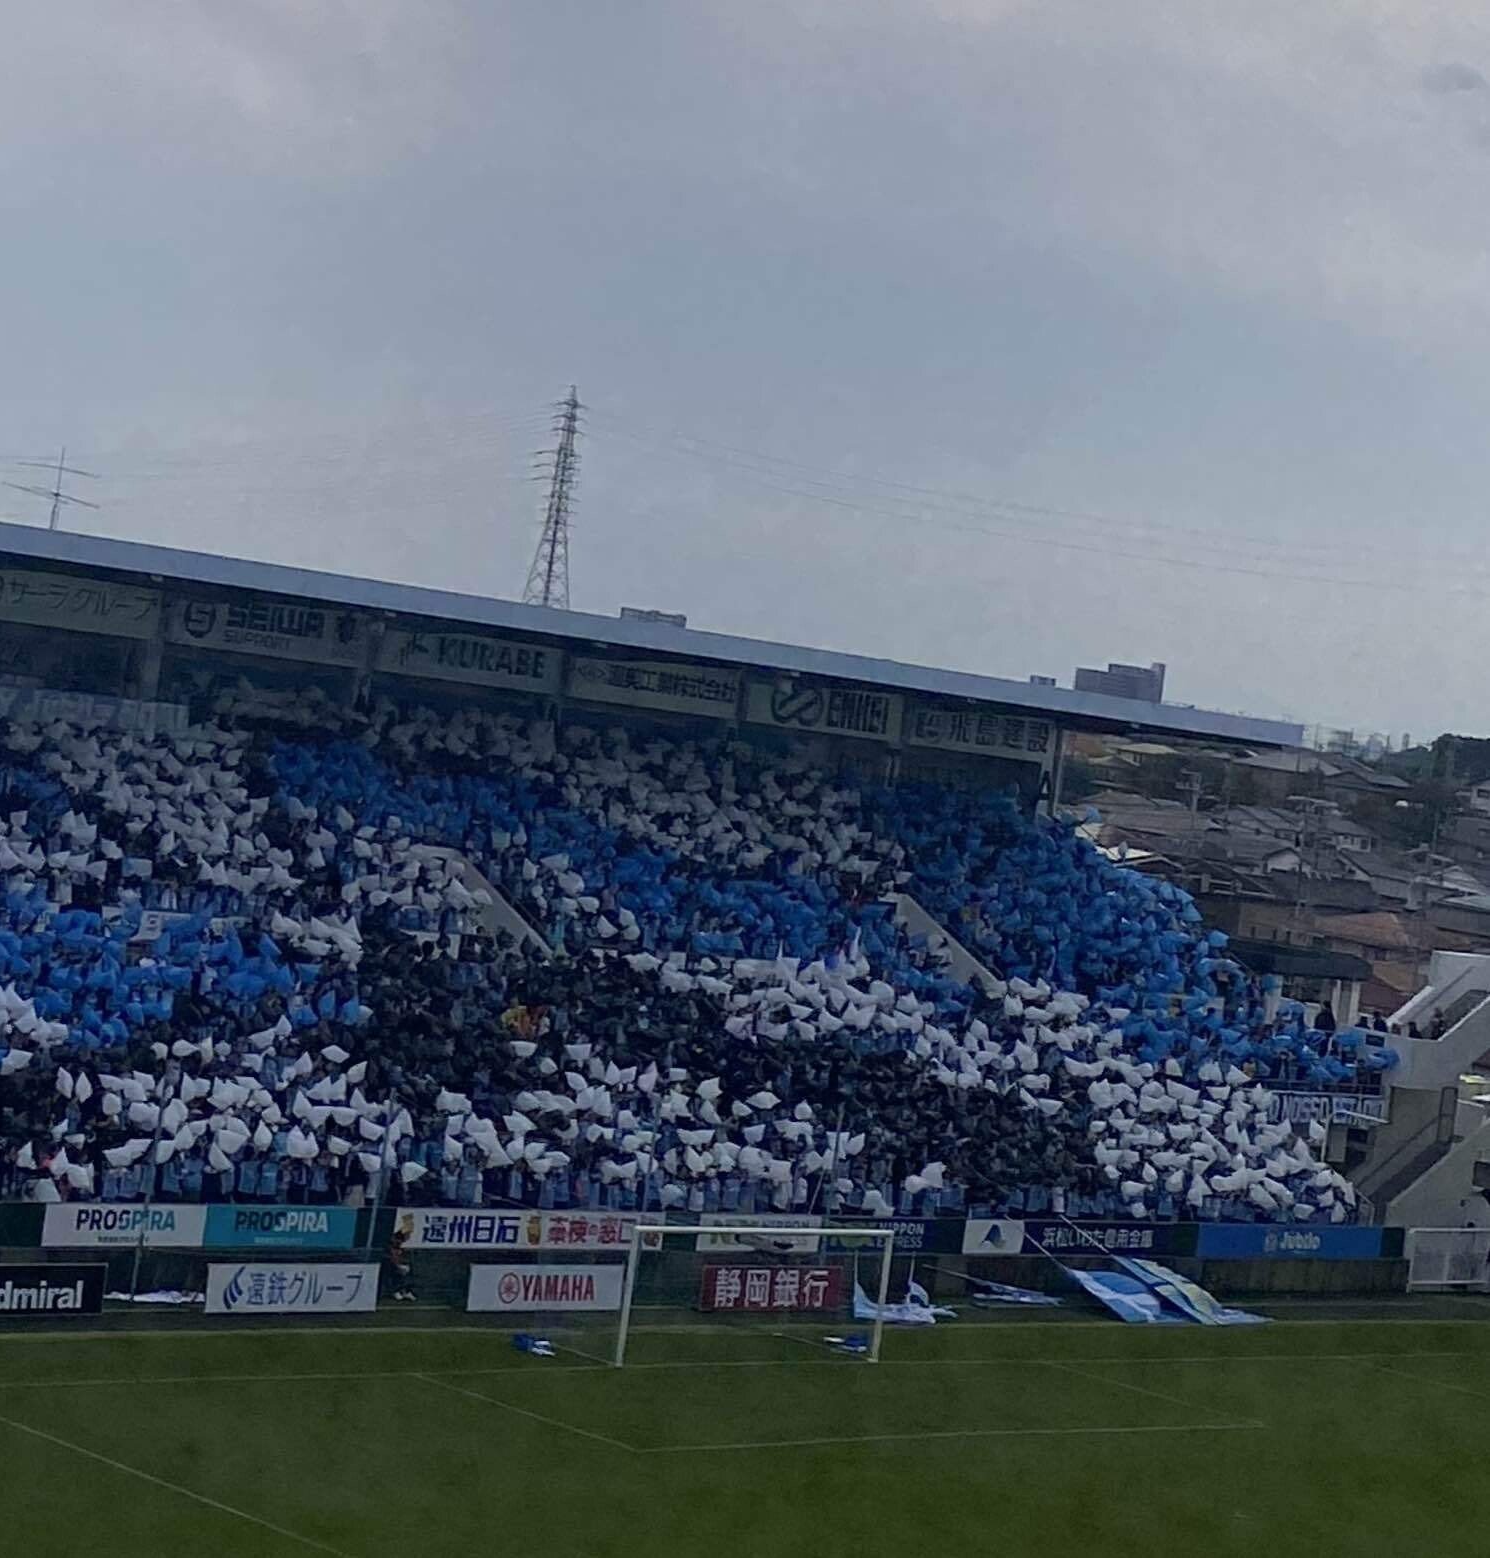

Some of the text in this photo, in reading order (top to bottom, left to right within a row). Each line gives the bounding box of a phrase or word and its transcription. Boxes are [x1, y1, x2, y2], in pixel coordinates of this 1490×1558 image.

[438, 636, 546, 679] KURABE
[950, 713, 1050, 753] 飛島建設
[75, 1209, 175, 1231] PROSPIRA
[234, 1211, 328, 1232] PROSPIRA
[421, 1214, 521, 1244] 遠州日石
[246, 1271, 364, 1306] 遠鉄グループ
[522, 1274, 595, 1301] YAMAHA
[714, 1268, 830, 1307] 静岡銀行
